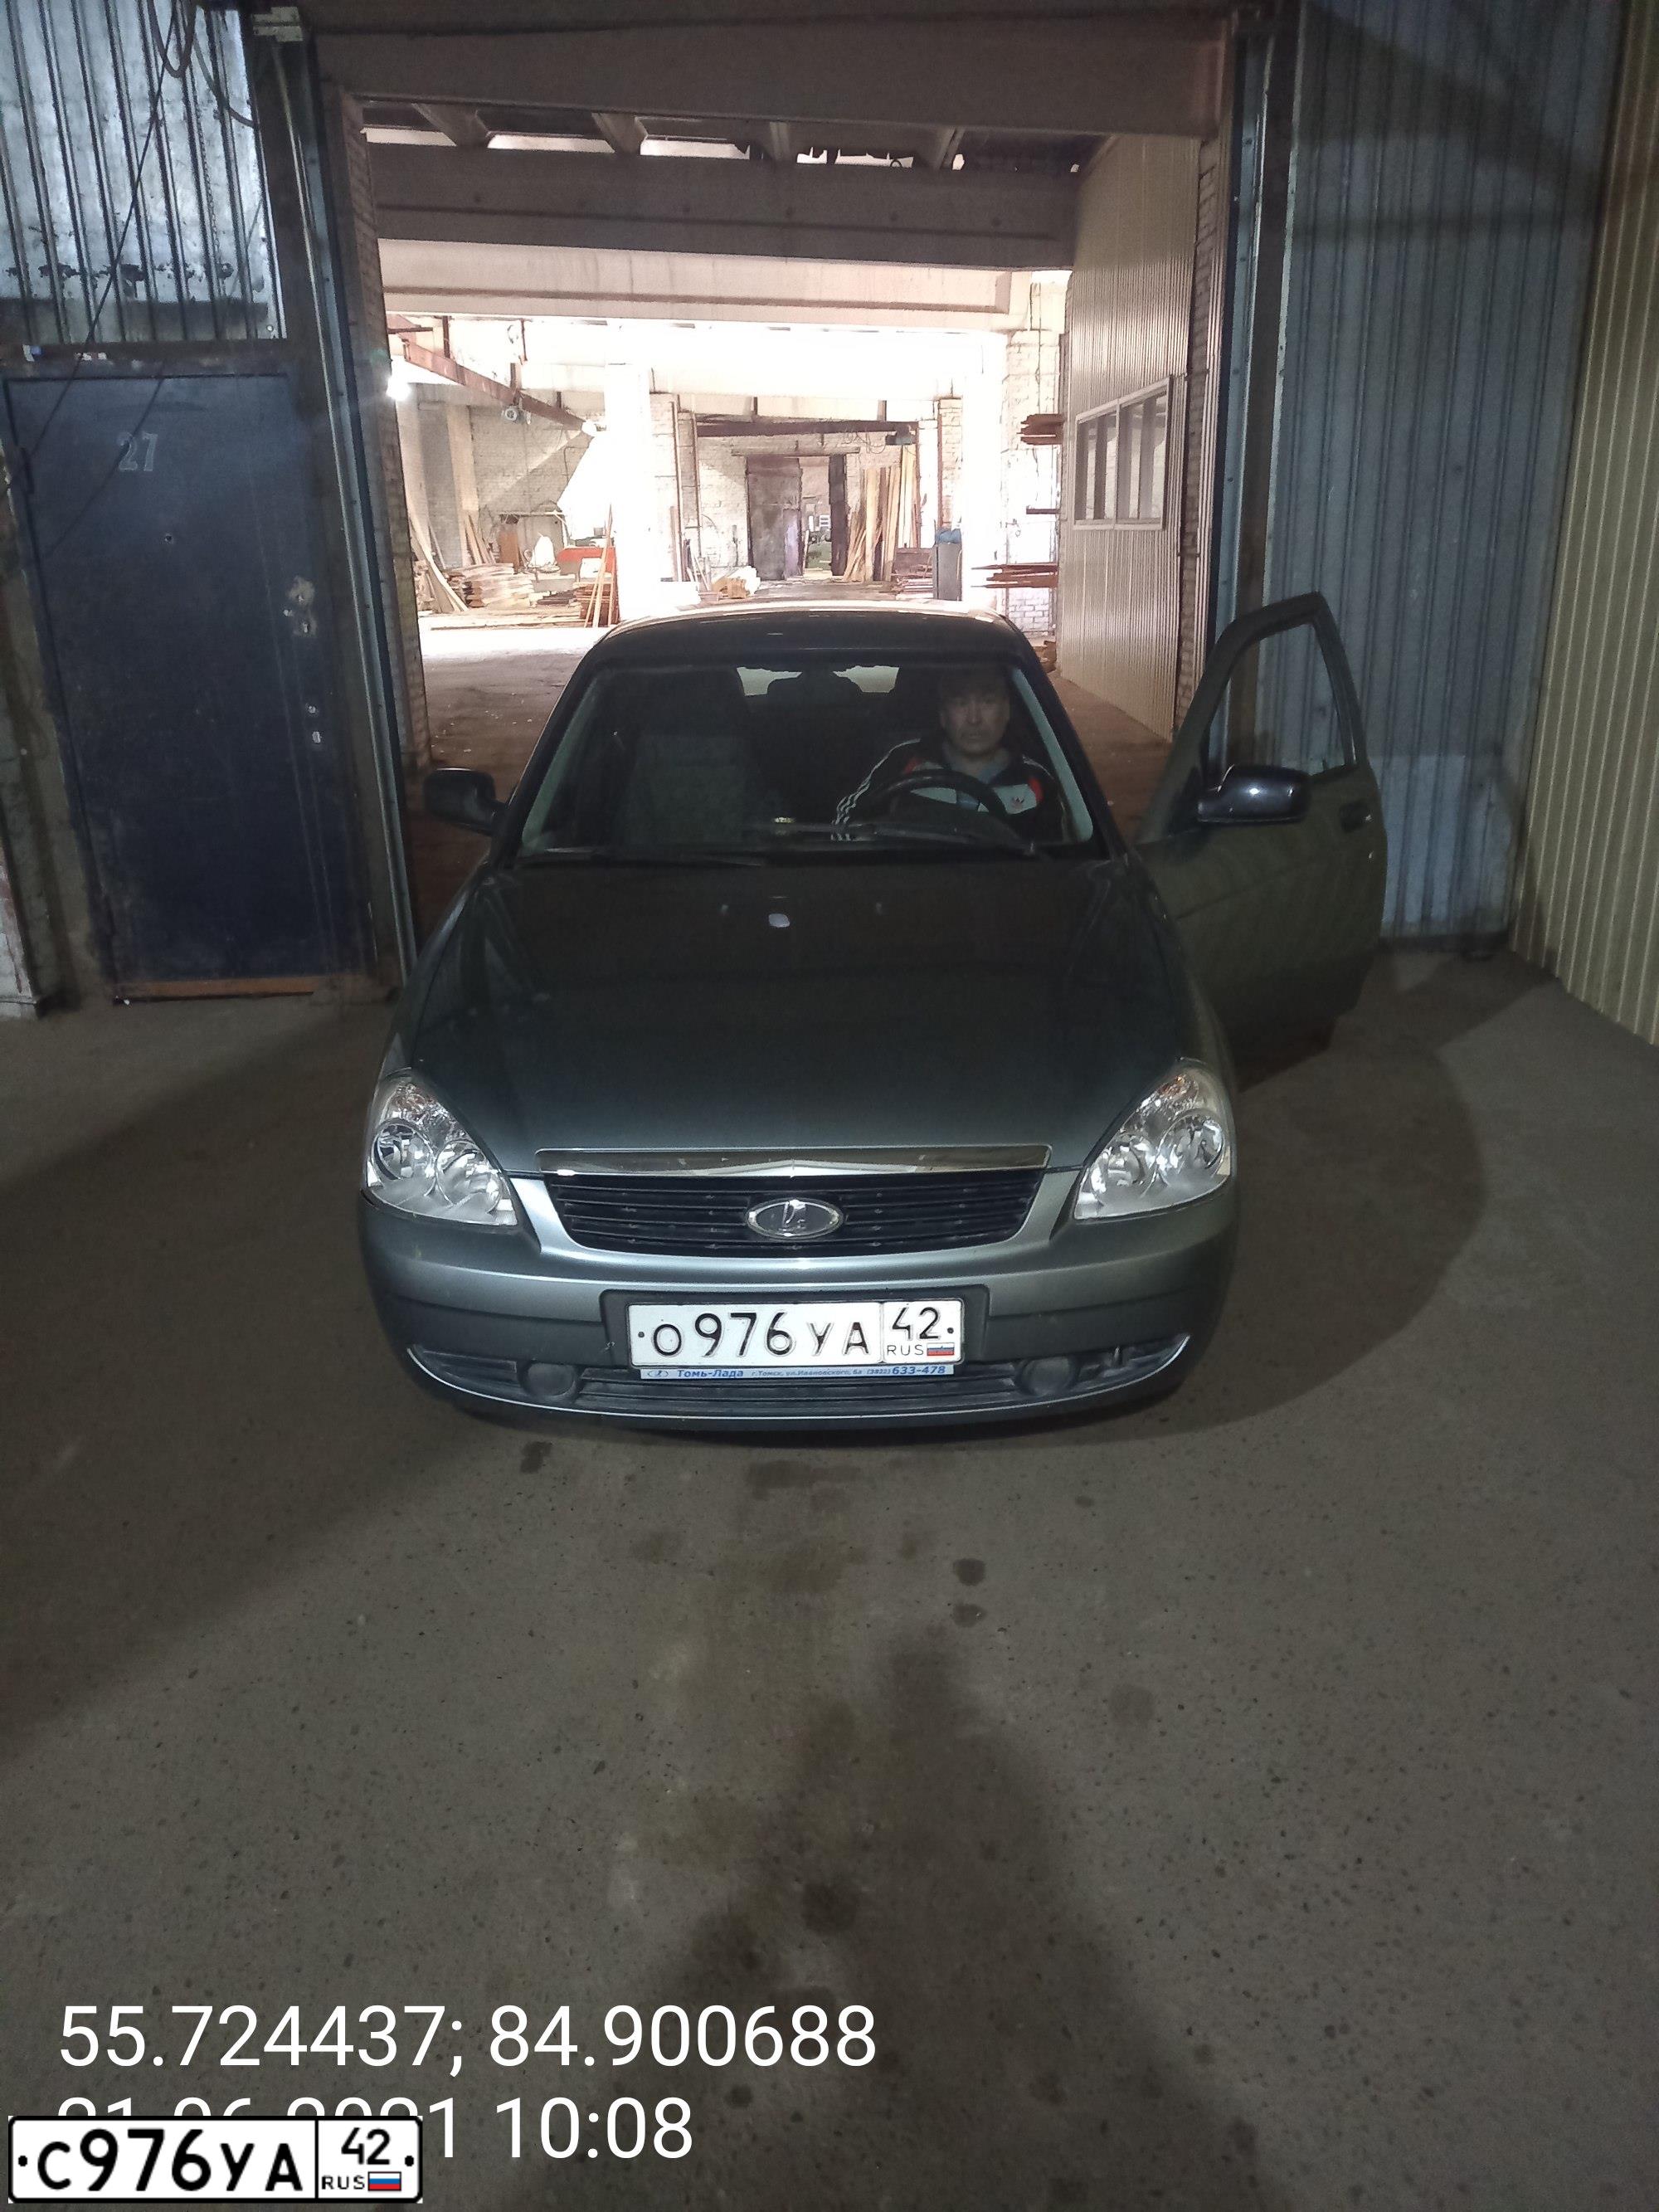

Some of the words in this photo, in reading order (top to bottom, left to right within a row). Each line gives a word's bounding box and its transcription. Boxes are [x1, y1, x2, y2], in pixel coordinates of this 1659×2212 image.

[892, 1307, 940, 1340] 42
[887, 1344, 924, 1356] RUS
[678, 1369, 744, 1378] Томь-Лада
[892, 1366, 946, 1375] 633-478
